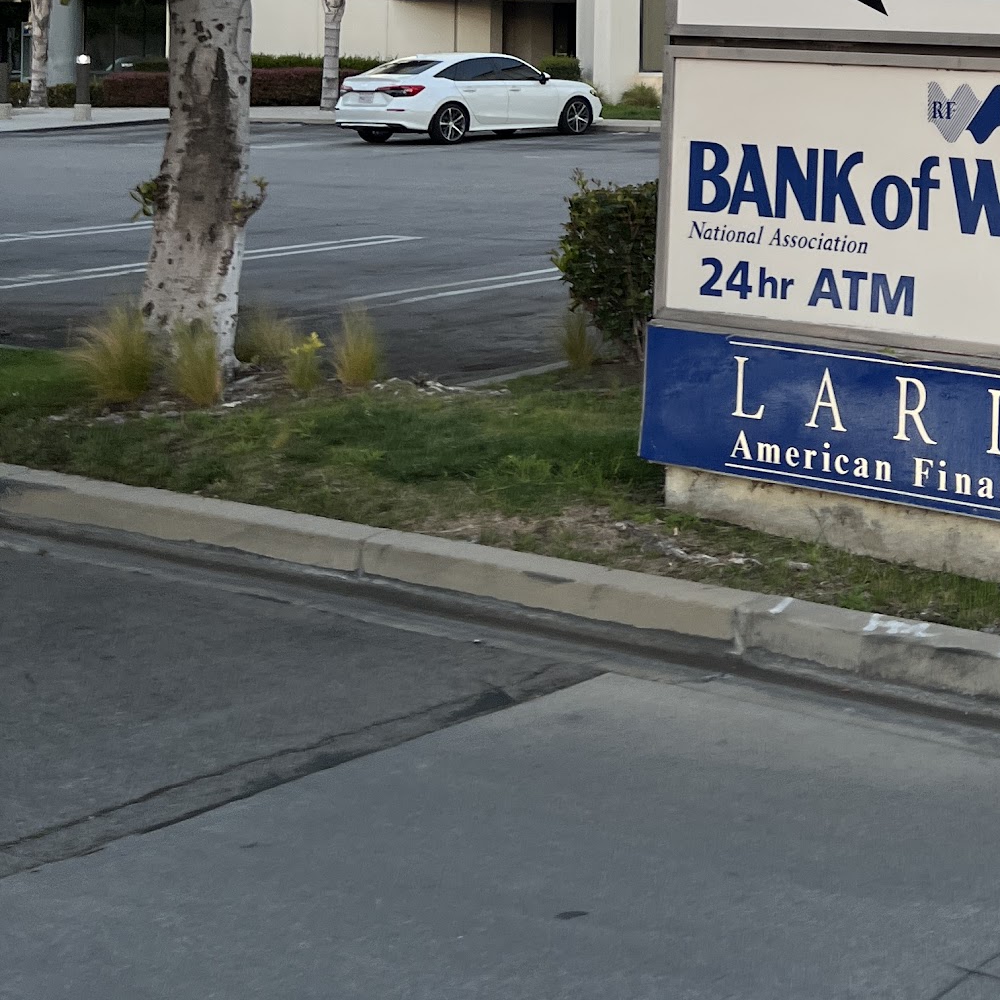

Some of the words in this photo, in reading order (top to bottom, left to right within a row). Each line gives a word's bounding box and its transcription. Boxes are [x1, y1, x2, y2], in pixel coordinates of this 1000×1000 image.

[687, 140, 867, 226] BANK
[870, 155, 941, 231] of
[687, 220, 765, 245] National
[768, 227, 869, 255] Association
[807, 267, 915, 317] ATM
[730, 430, 892, 482] American
